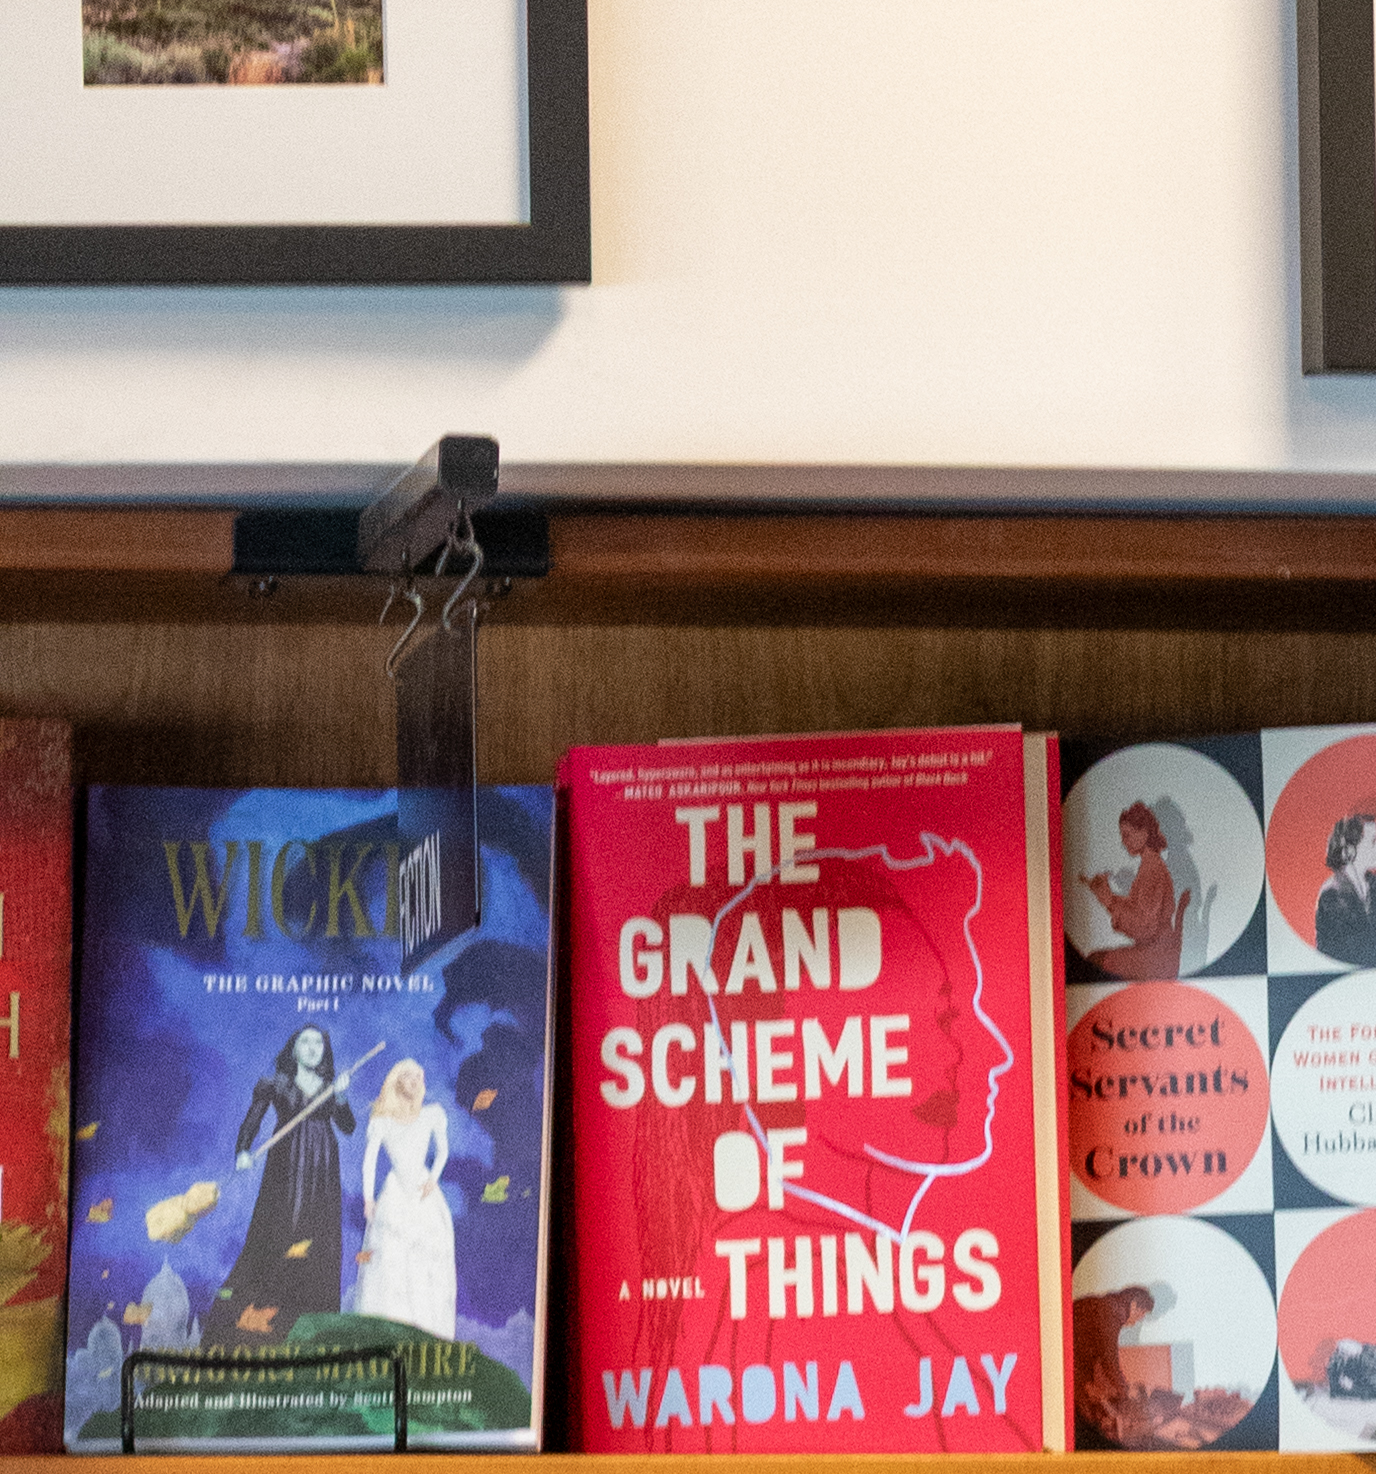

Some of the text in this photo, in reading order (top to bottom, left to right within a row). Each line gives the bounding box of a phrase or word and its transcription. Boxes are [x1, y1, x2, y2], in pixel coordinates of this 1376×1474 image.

[676, 801, 820, 889] THE
[398, 829, 441, 958] FICTION
[618, 907, 884, 999] GRAND
[204, 975, 433, 994] THE GRAPHIC NOVEL
[1091, 1014, 1226, 1052] Secret
[1308, 1023, 1344, 1042] THE
[599, 1013, 913, 1109] SCHEME
[1294, 1048, 1362, 1068] WOMEN
[1071, 1069, 1249, 1101] Servants
[1124, 1112, 1201, 1135] of the
[712, 1126, 809, 1213] OF
[1085, 1148, 1229, 1180] Crown
[618, 1279, 705, 1301] A NOVEL
[714, 1229, 1001, 1320] THINGS
[134, 1393, 198, 1410] Adapted
[205, 1393, 234, 1409] and
[239, 1392, 323, 1409] Illustrated
[330, 1392, 347, 1409] by
[601, 1352, 1019, 1430] WARONA JAY
